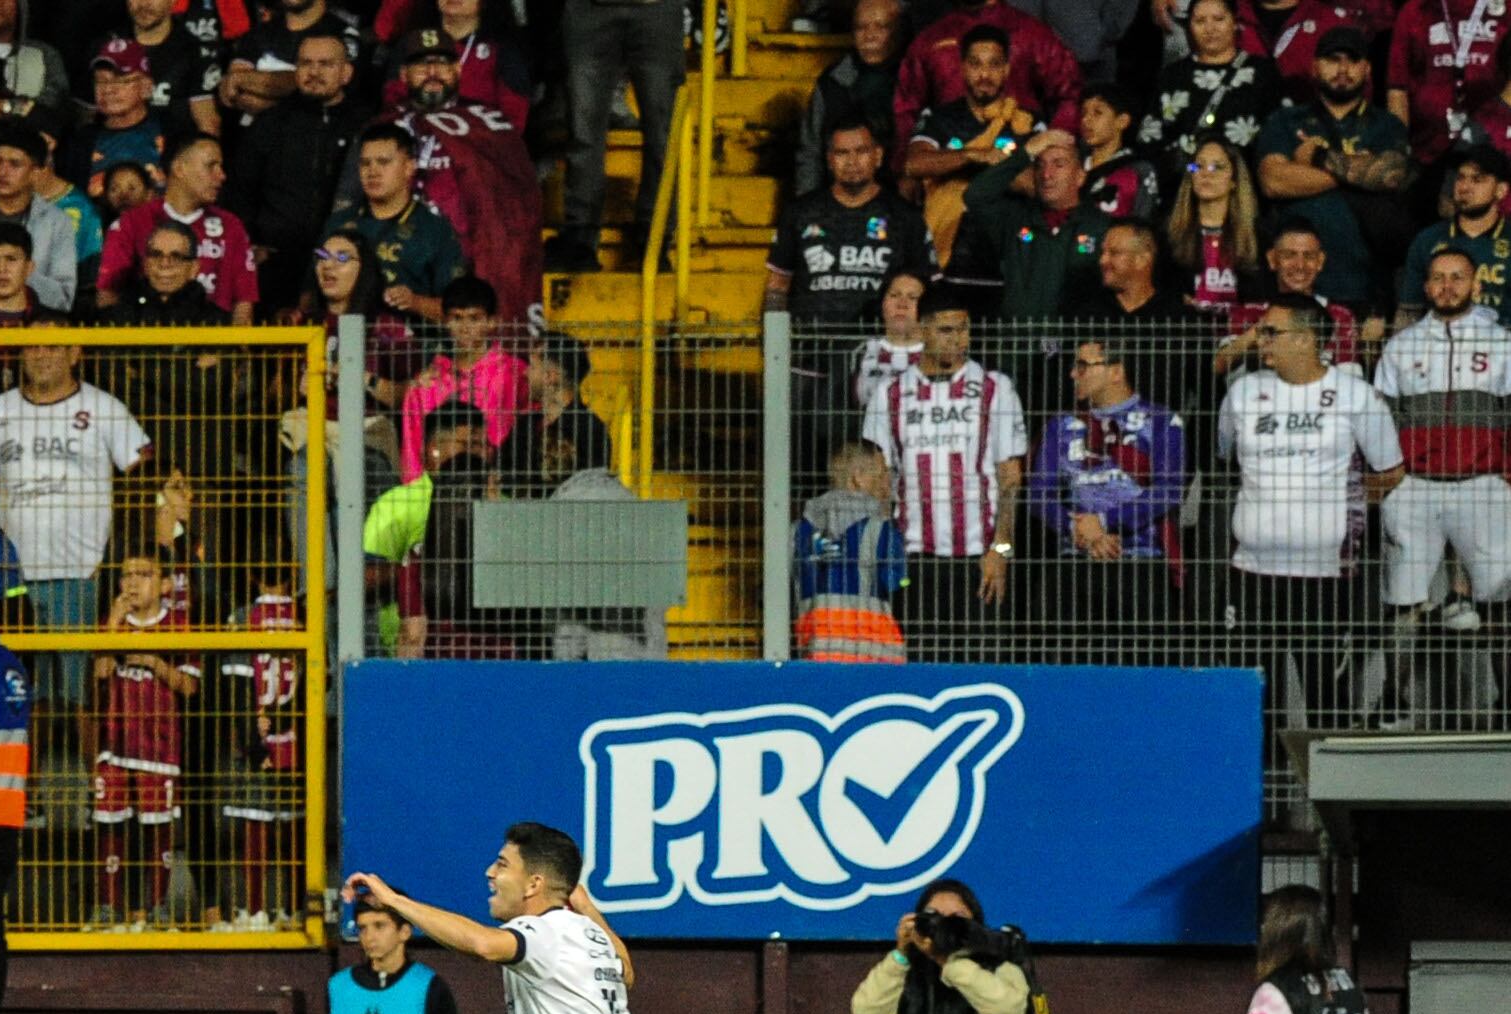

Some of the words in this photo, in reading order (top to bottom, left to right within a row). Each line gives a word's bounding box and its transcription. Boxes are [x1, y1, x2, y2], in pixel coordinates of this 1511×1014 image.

[203, 216, 224, 238] S
[838, 245, 892, 269] BAC
[809, 274, 883, 292] LIBERTY
[1471, 351, 1489, 374] S
[965, 380, 981, 399] S
[1319, 389, 1337, 408] S
[73, 410, 92, 431] S
[930, 405, 974, 424] BAC
[1286, 412, 1325, 430] BAC
[32, 436, 81, 457] BAC
[602, 709, 1000, 887] PRO
